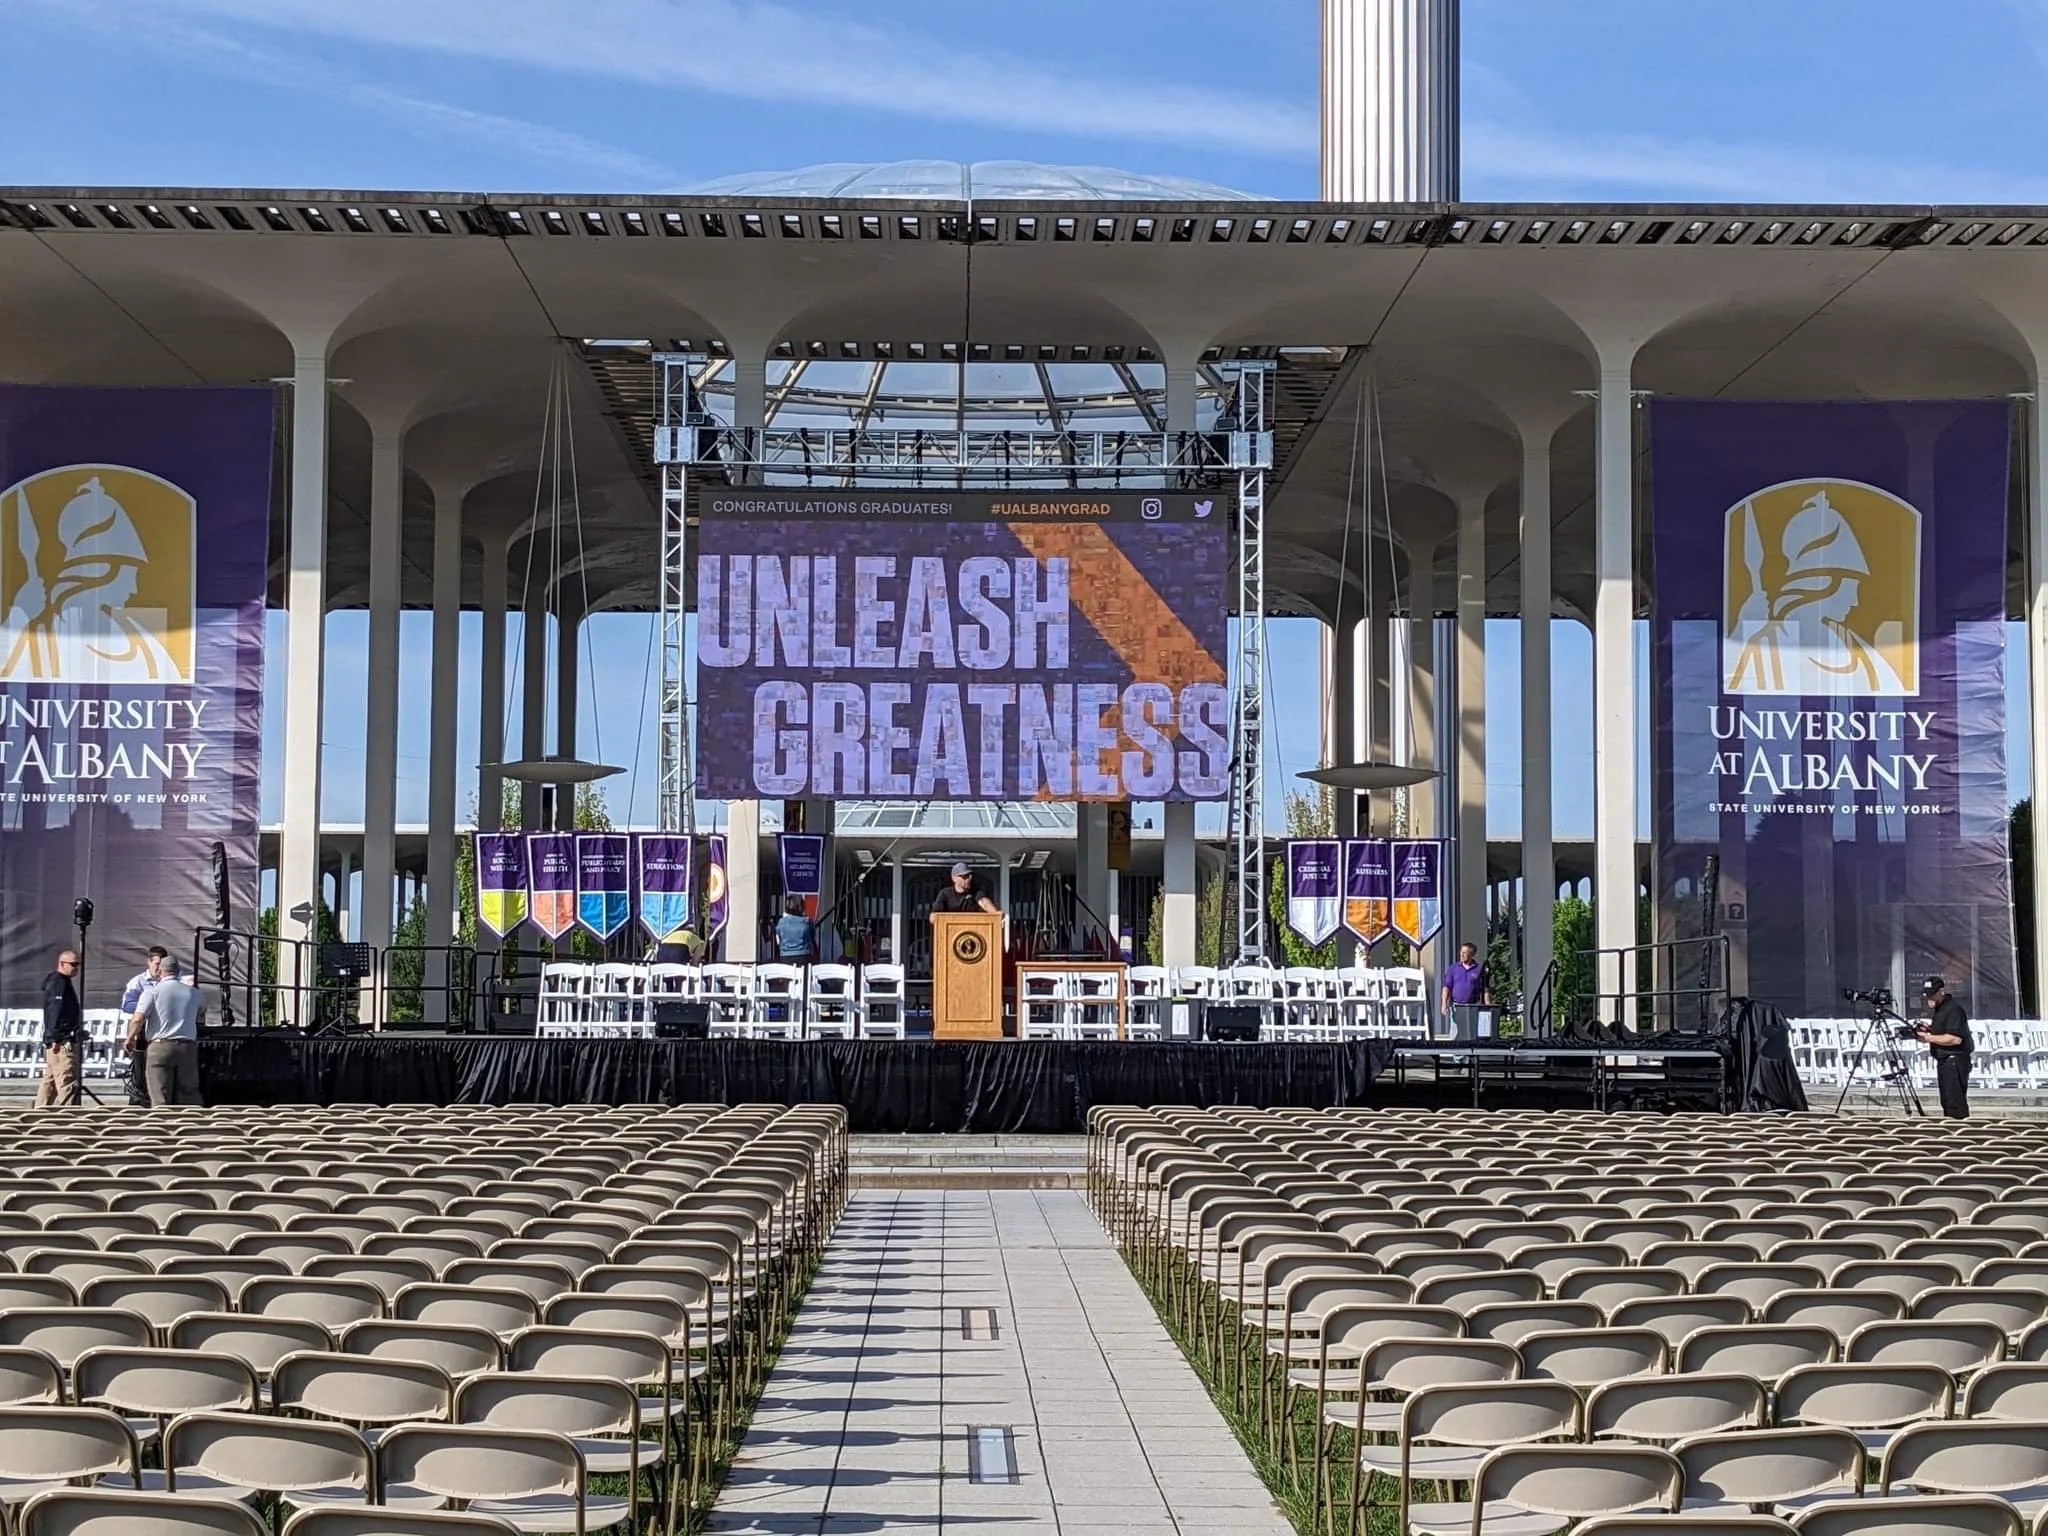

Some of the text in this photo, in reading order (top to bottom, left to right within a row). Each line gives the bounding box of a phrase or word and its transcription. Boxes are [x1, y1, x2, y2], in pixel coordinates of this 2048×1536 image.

[712, 500, 952, 516] CONGRATULATIONS GRADUATES!
[991, 503, 1111, 516] #UALBANYGRAD
[698, 554, 1070, 670] UNLEASH
[752, 680, 1229, 798] GREATNESS
[1708, 706, 1938, 741] UNIVERSITY
[7, 734, 209, 784] ALBANY
[1708, 745, 1939, 796] AT ALBANY
[22, 793, 108, 803] UNIVERSITY
[114, 793, 131, 803] OF
[137, 793, 166, 803] NEW
[172, 793, 208, 803] YORK
[1708, 803, 1941, 815] STATE UNIVERSITY OF NEW YORK
